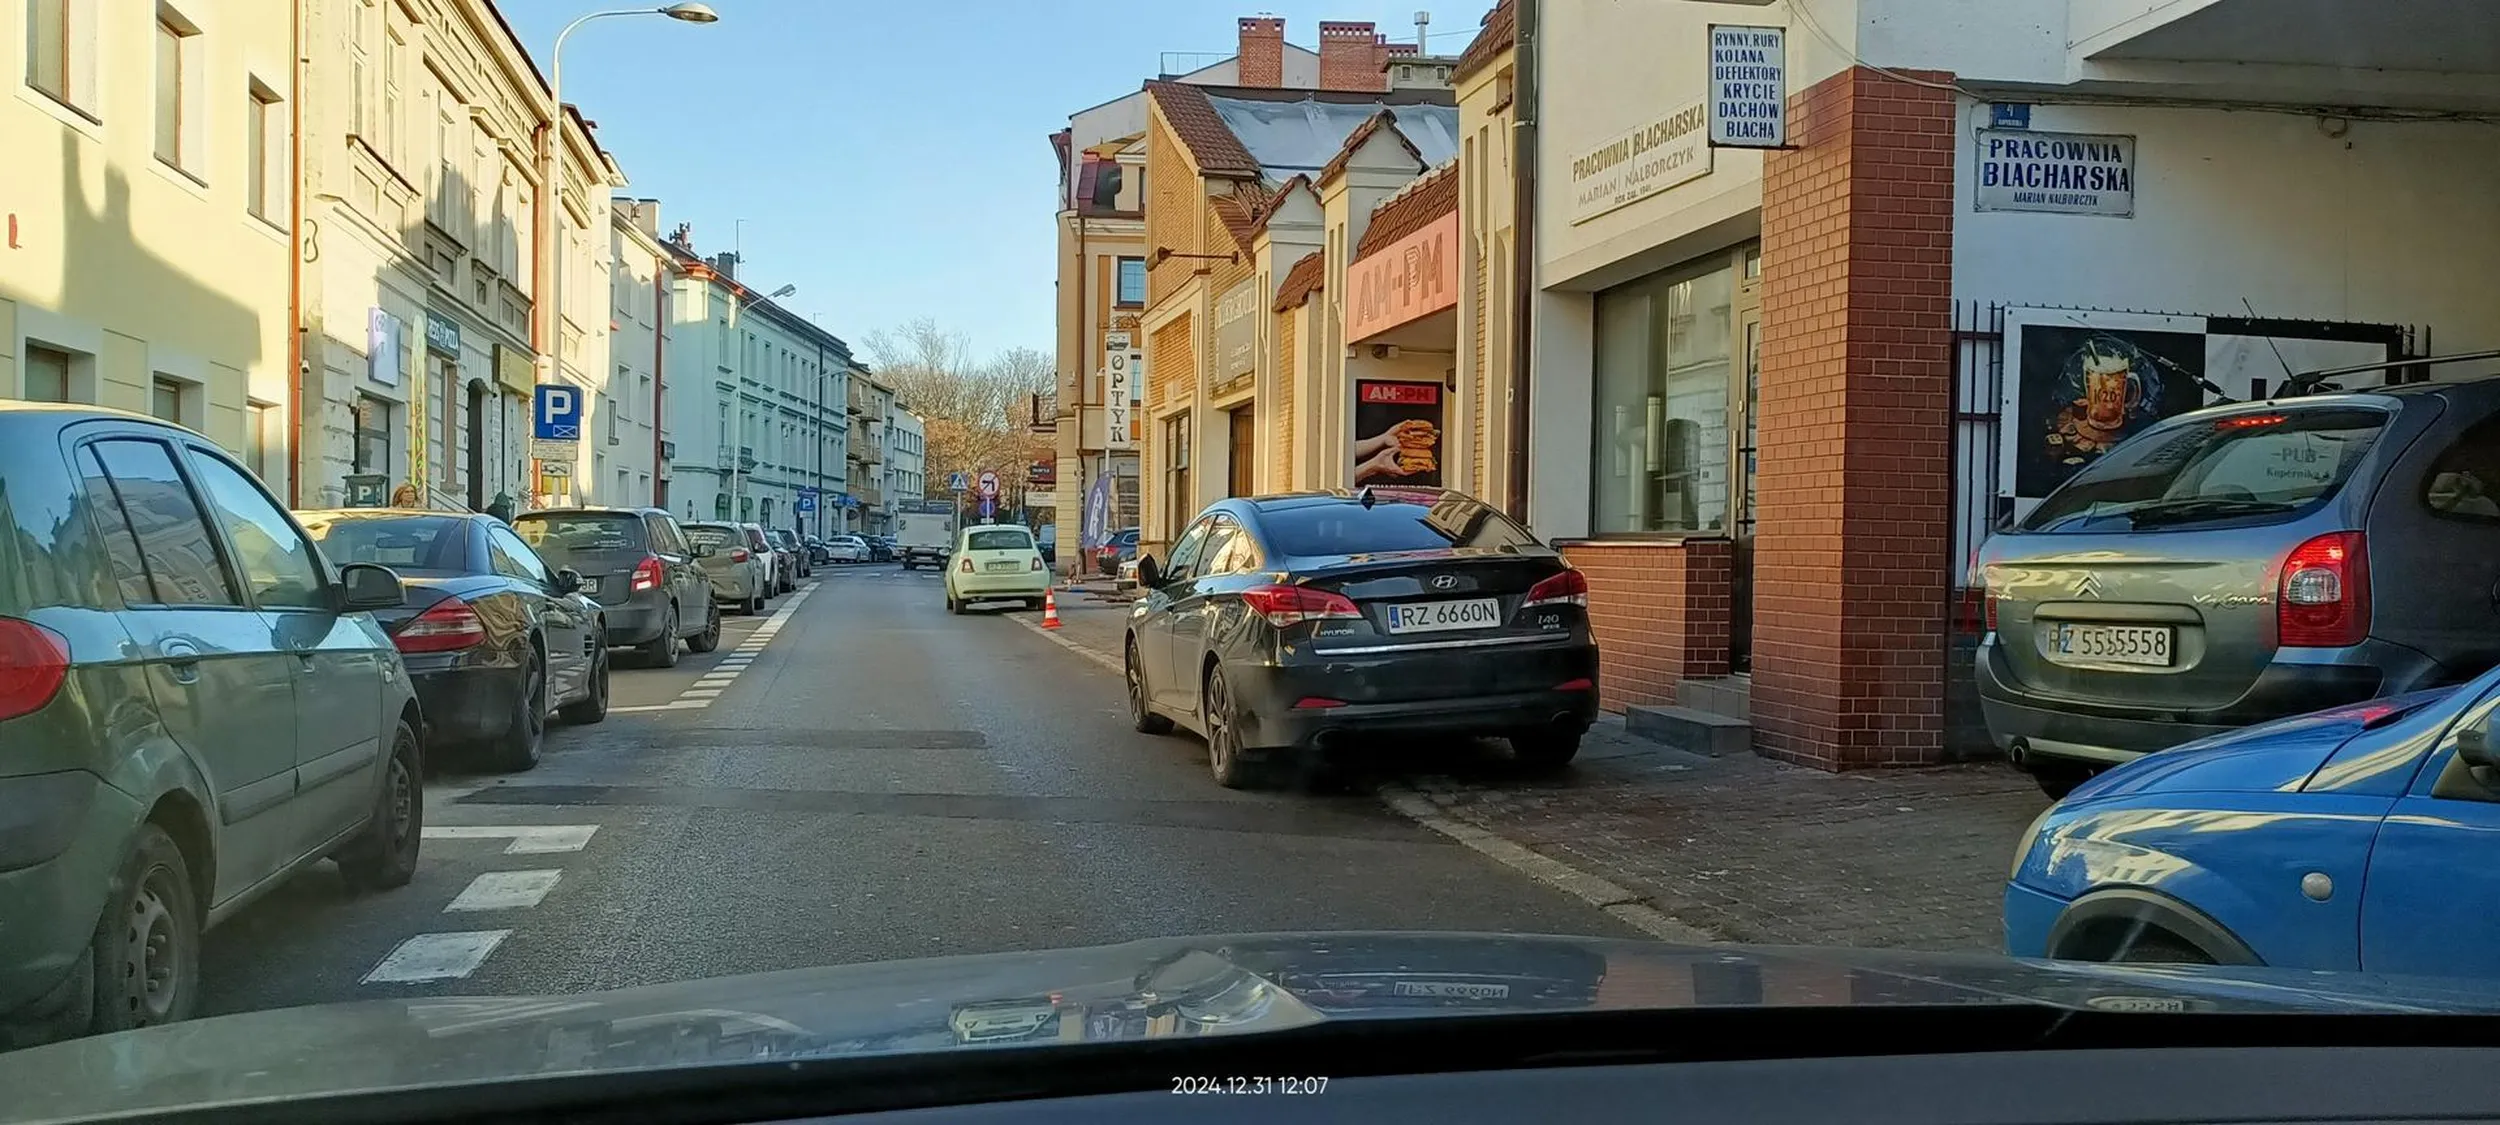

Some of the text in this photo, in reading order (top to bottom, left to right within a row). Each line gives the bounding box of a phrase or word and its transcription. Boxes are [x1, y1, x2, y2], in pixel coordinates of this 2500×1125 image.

[1715, 49, 1764, 63] KOLANA
[1715, 66, 1782, 81] DEFLEKTORY
[1723, 83, 1776, 100] KRYCIE
[1719, 101, 1779, 119] DACHÓW
[1573, 103, 1705, 183] PRACOWNIA BLACHARSKA
[1726, 121, 1775, 140] BLACHĄ
[1990, 138, 2122, 163] PRACOWNIA
[1578, 146, 1694, 208] MARIAN NALBORCZYK
[1983, 162, 2130, 192] BLACHARSKA
[2013, 192, 2099, 206] MARIAN NALBORCZYK
[545, 389, 572, 424] P
[1110, 354, 1126, 443] OPTYK
[1401, 602, 1496, 627] RZ 6660N
